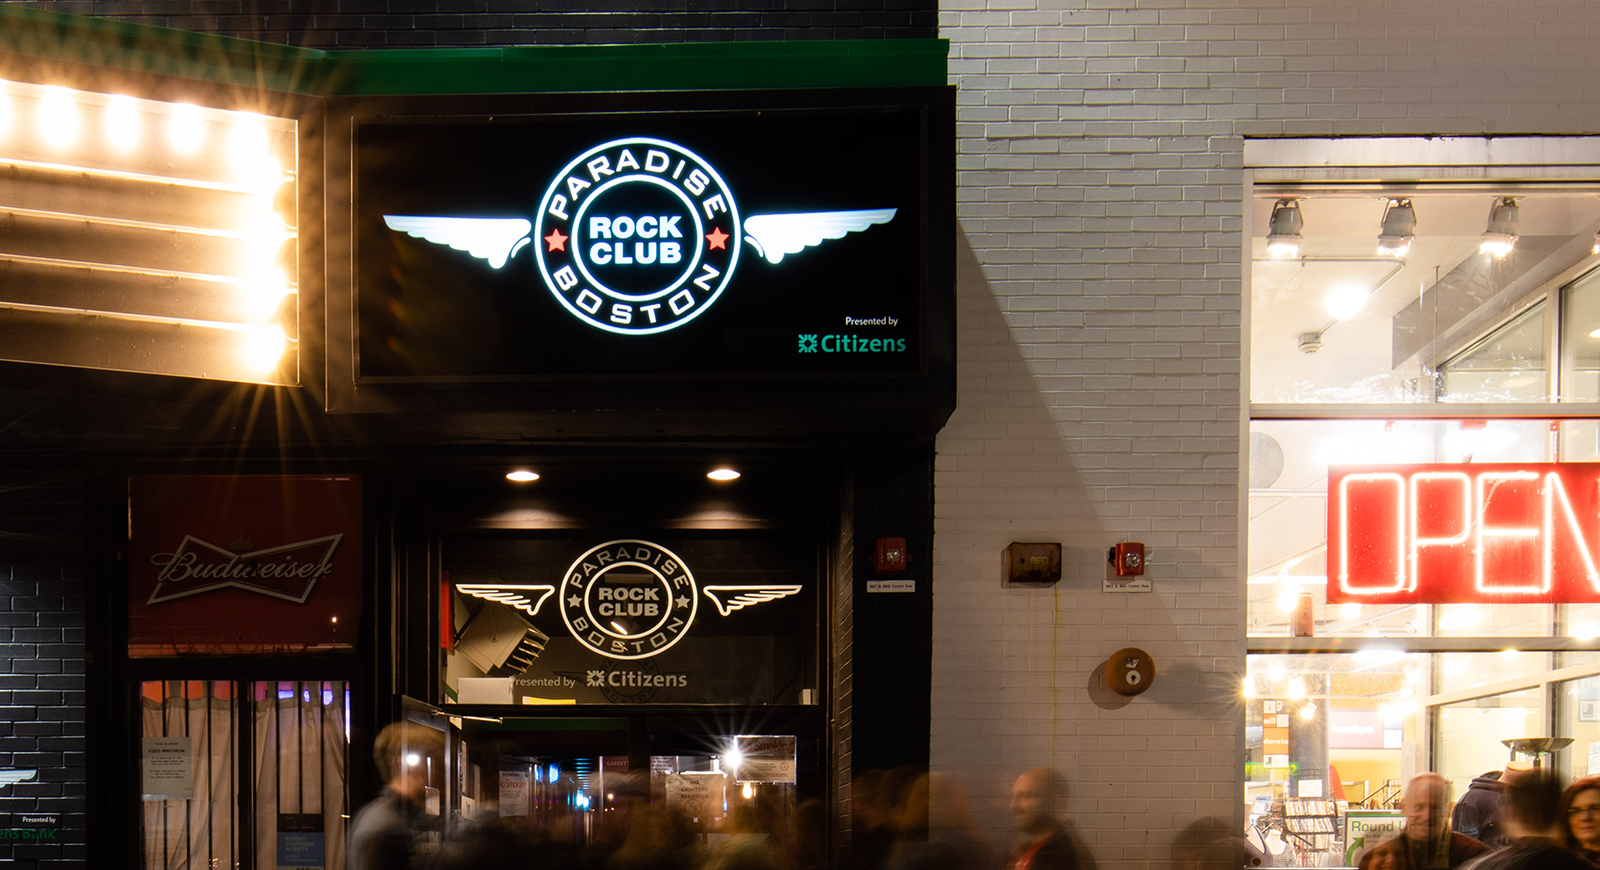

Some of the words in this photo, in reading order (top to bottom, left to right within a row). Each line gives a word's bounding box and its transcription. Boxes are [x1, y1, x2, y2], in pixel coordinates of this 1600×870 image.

[548, 148, 728, 221] PARADISE
[589, 215, 683, 240] ROCK
[589, 241, 682, 265] CLUB
[553, 264, 721, 325] BOSTON
[845, 316, 885, 326] Presented
[887, 316, 898, 328] by
[820, 333, 906, 354] Citizens
[1339, 470, 1600, 595] OPEN
[151, 552, 333, 582] Budweiser
[570, 547, 690, 589] PARADISE
[1030, 556, 1049, 564] BFD
[599, 587, 659, 601] ROCK
[599, 603, 659, 616] CLUB
[572, 616, 684, 653] BOSTON
[510, 676, 561, 688] Presented
[563, 676, 576, 689] by
[608, 671, 687, 688] Citizens
[49, 816, 56, 824] by
[1351, 820, 1394, 832] Round
[22, 827, 56, 839] Bank
